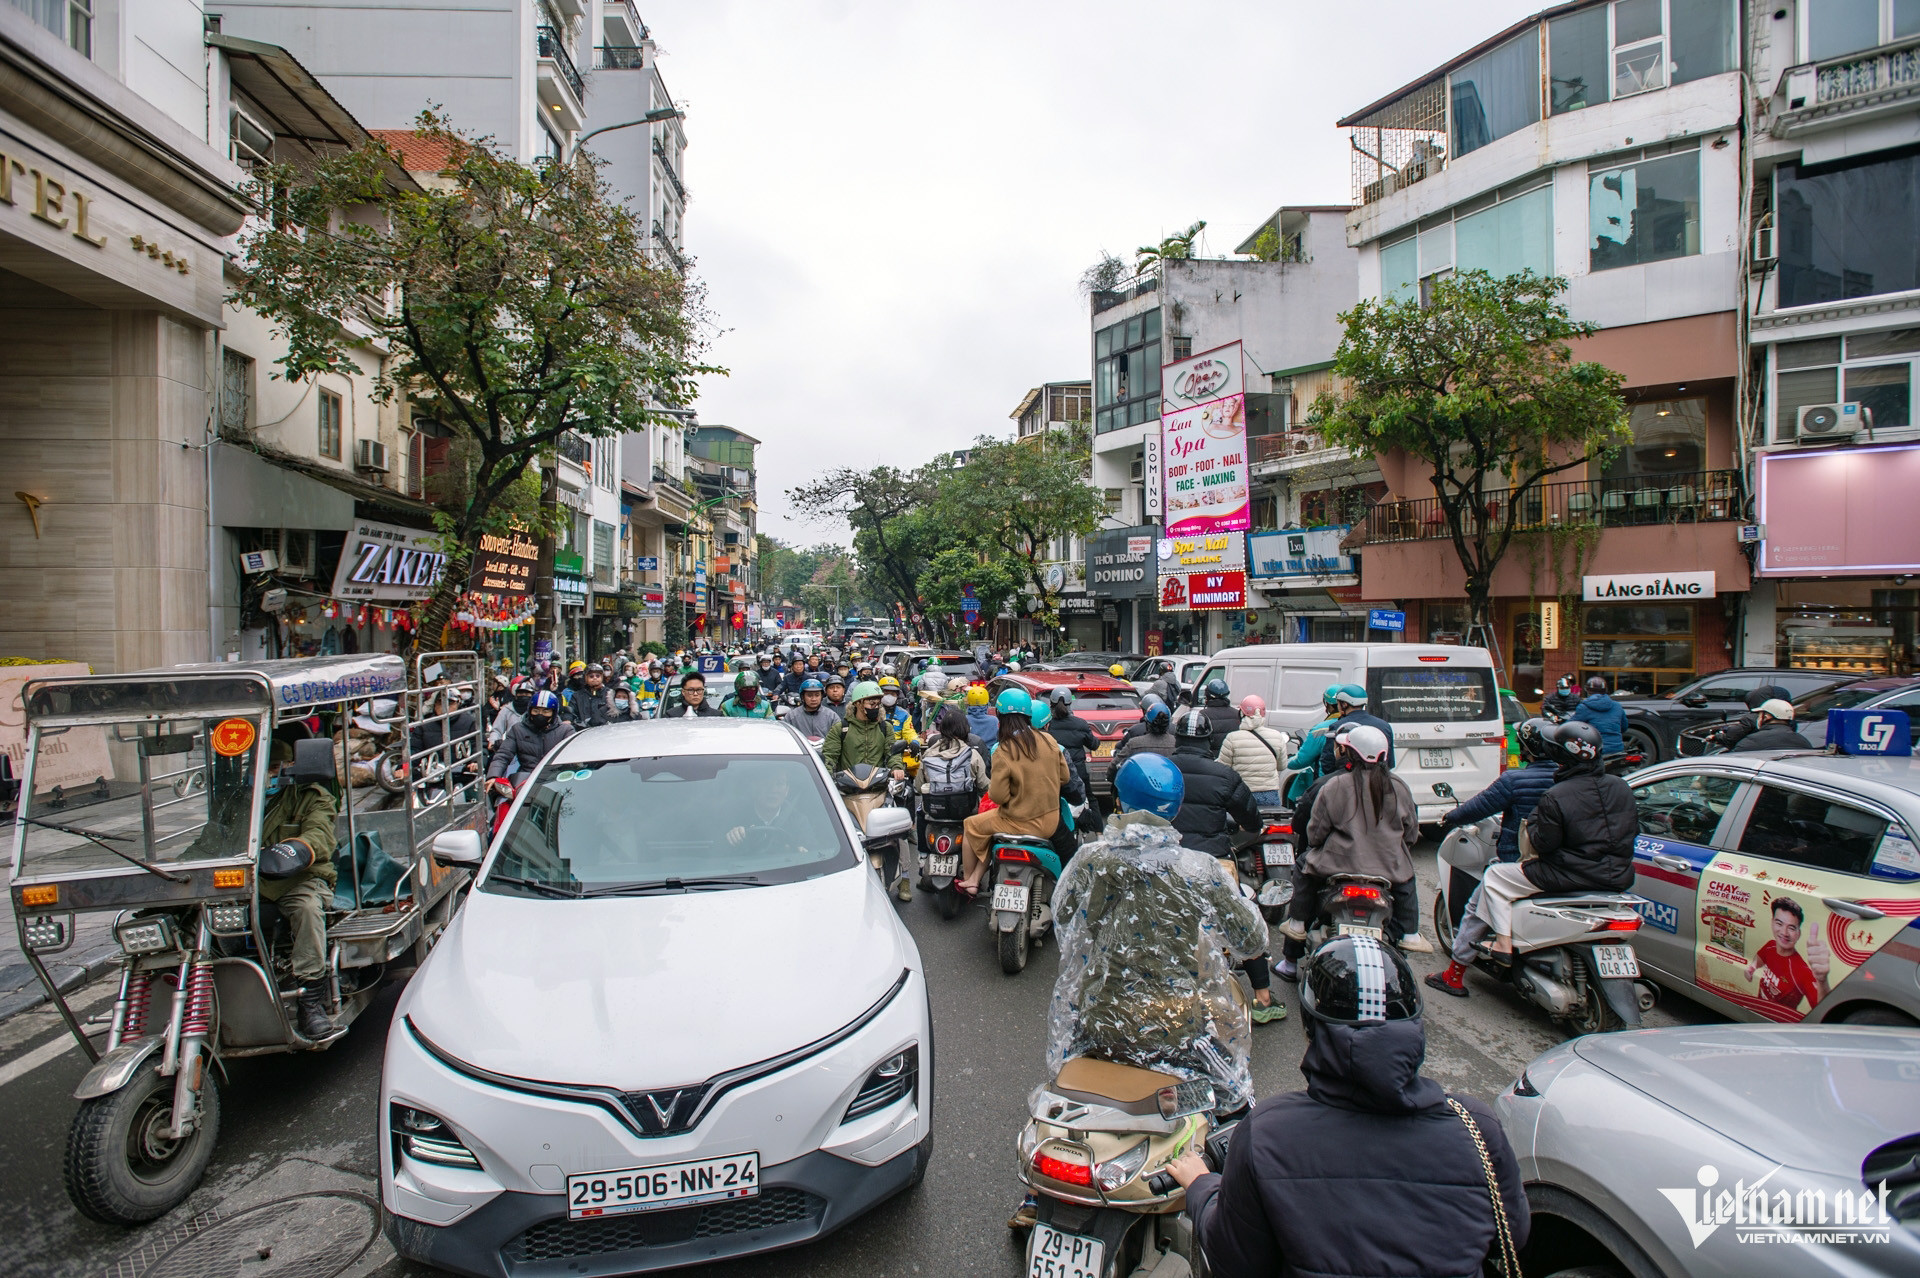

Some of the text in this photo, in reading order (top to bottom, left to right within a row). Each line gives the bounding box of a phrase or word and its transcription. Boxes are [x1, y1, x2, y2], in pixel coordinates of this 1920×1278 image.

[1185, 371, 1222, 398] Open
[1168, 419, 1192, 431] Lan
[1171, 436, 1206, 458] Spa
[1169, 453, 1242, 478] BODY FOOT NAIL
[1149, 442, 1158, 508] DOMINO
[1176, 470, 1236, 492] FACE WAXING
[1173, 536, 1229, 556] Spa Nail
[352, 543, 446, 586] ZAKER
[1094, 552, 1146, 566] THỜI TRANG
[1180, 556, 1222, 565] RELAXING
[1094, 568, 1145, 583] DOMINO
[1207, 576, 1223, 588] NY
[1067, 599, 1095, 608] CORNER
[1192, 591, 1240, 604] MINIMART
[704, 657, 719, 671] G7
[282, 684, 300, 704] C5
[1861, 715, 1896, 751] G7
[1858, 743, 1878, 751] TAXI
[1424, 757, 1449, 767] 019.12
[1647, 843, 1664, 854] 32
[1267, 855, 1292, 864] 262.92
[932, 864, 953, 874] 3430
[1777, 876, 1795, 886] RUN
[995, 897, 1025, 910] 001.55
[1601, 962, 1637, 976] 048.13
[1052, 1145, 1083, 1158] HONDA
[572, 1159, 755, 1205] 29-506-NN-24
[1041, 1229, 1093, 1268] 29-P1
